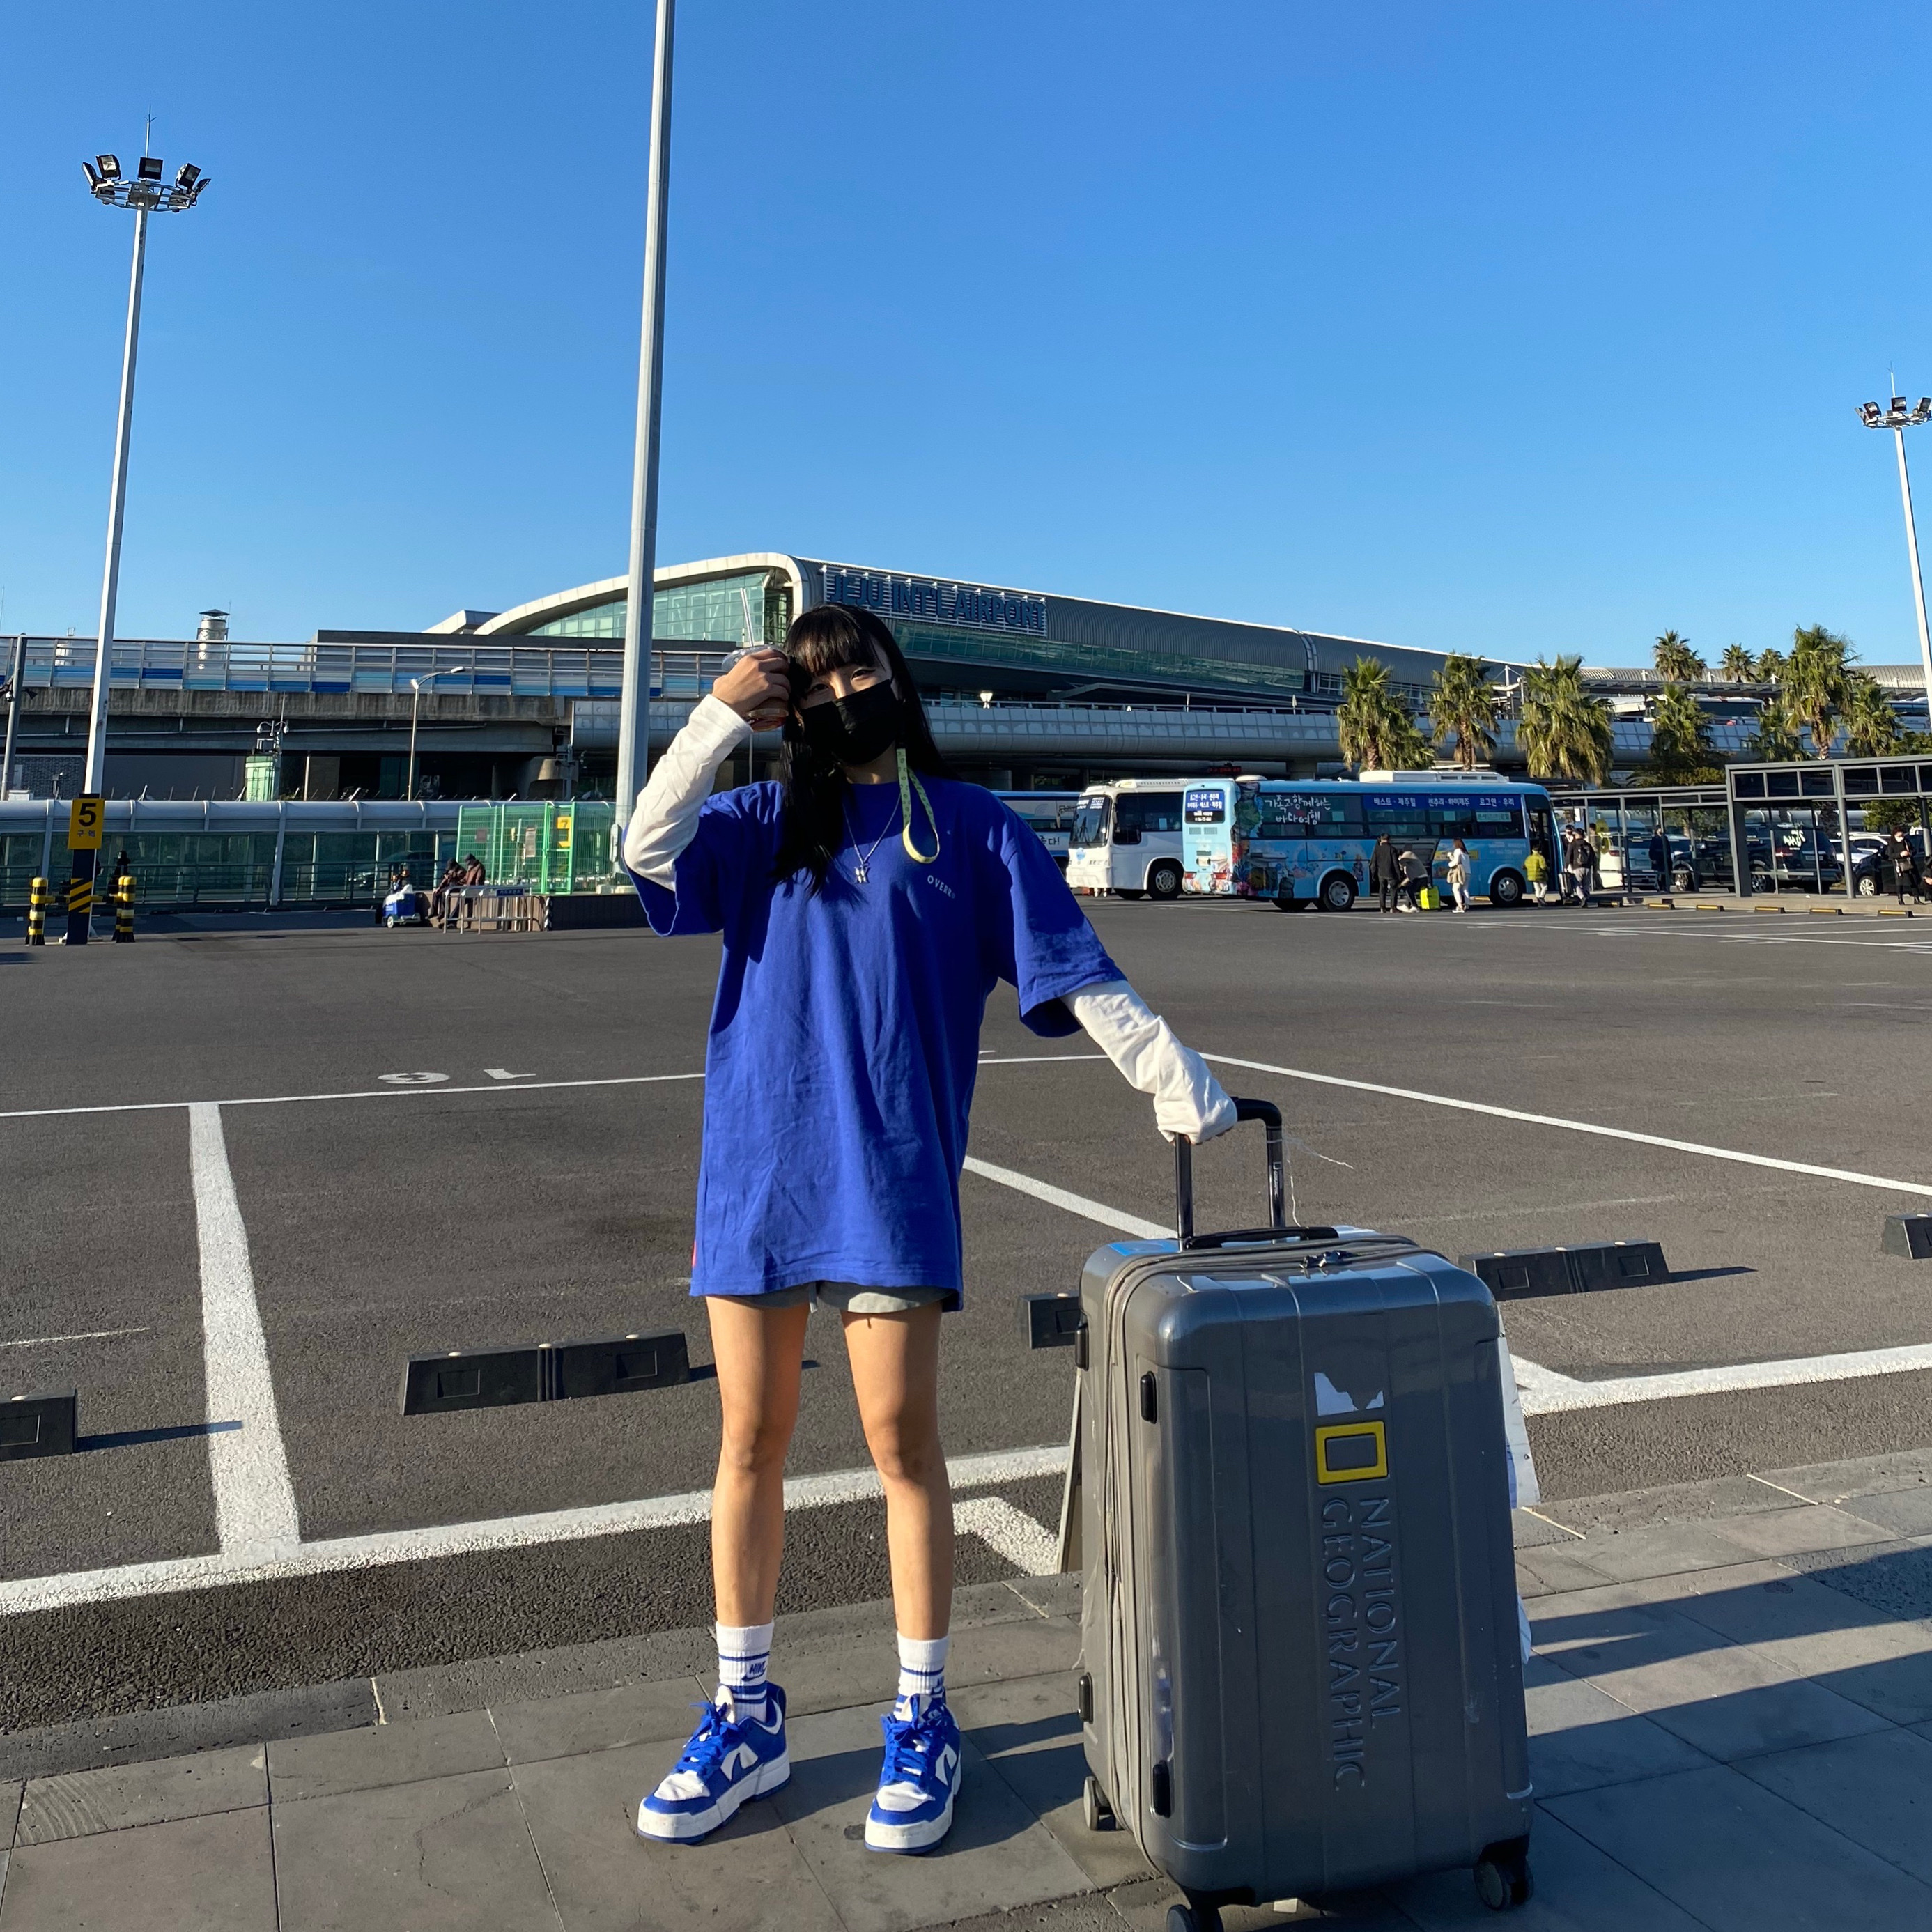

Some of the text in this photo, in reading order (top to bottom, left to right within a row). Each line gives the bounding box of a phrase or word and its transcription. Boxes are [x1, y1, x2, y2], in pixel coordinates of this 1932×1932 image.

[830, 573, 1046, 628] JEJU INT'L AIRPORT
[78, 803, 97, 827] 5
[1275, 809, 1321, 825] 바다여행
[1503, 798, 1515, 807] 우리
[1359, 1498, 1401, 1729] NATIONAL
[1322, 1497, 1366, 1791] GEOGRAPHIC
